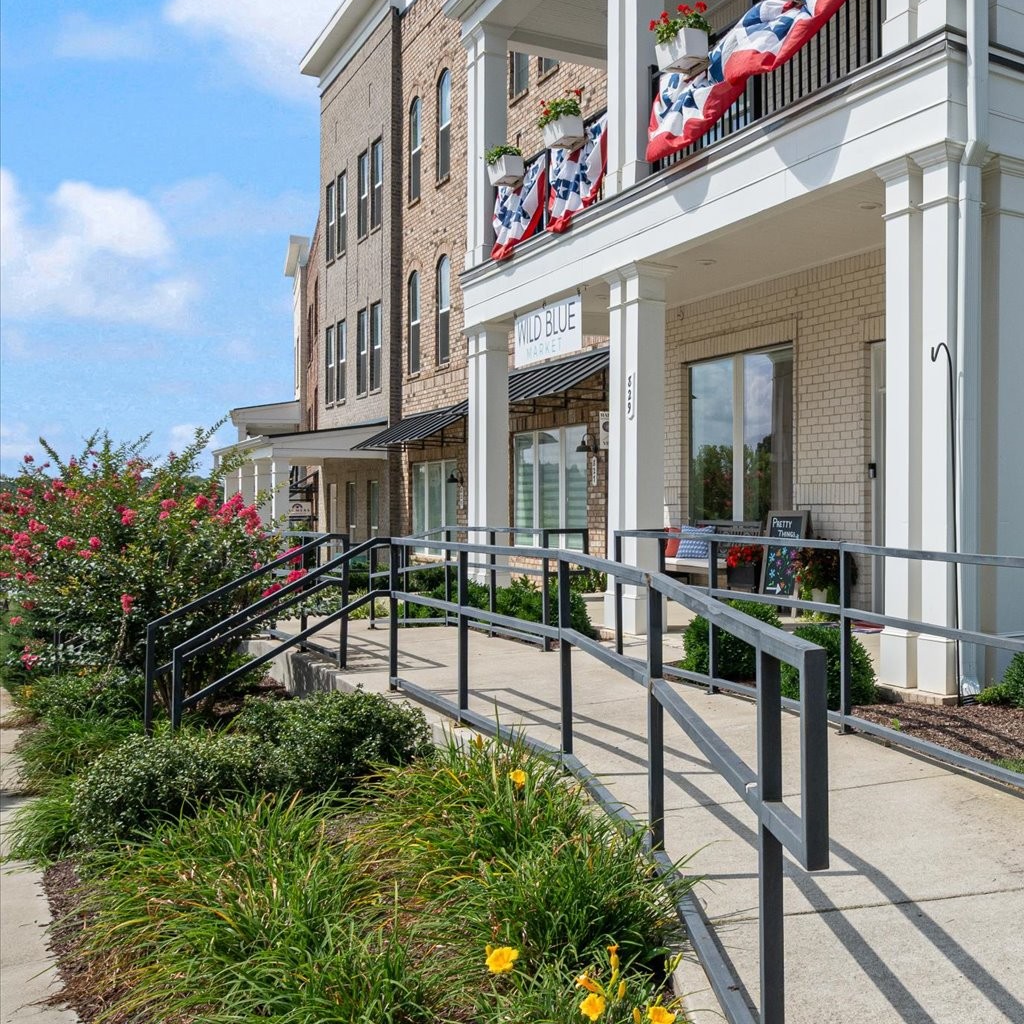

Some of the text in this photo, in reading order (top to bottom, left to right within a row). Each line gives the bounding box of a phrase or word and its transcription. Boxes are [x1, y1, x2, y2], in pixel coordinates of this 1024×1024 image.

[517, 301, 576, 347] WILD BLUE
[526, 337, 562, 359] MARKET
[772, 517, 792, 528] PRETTY
